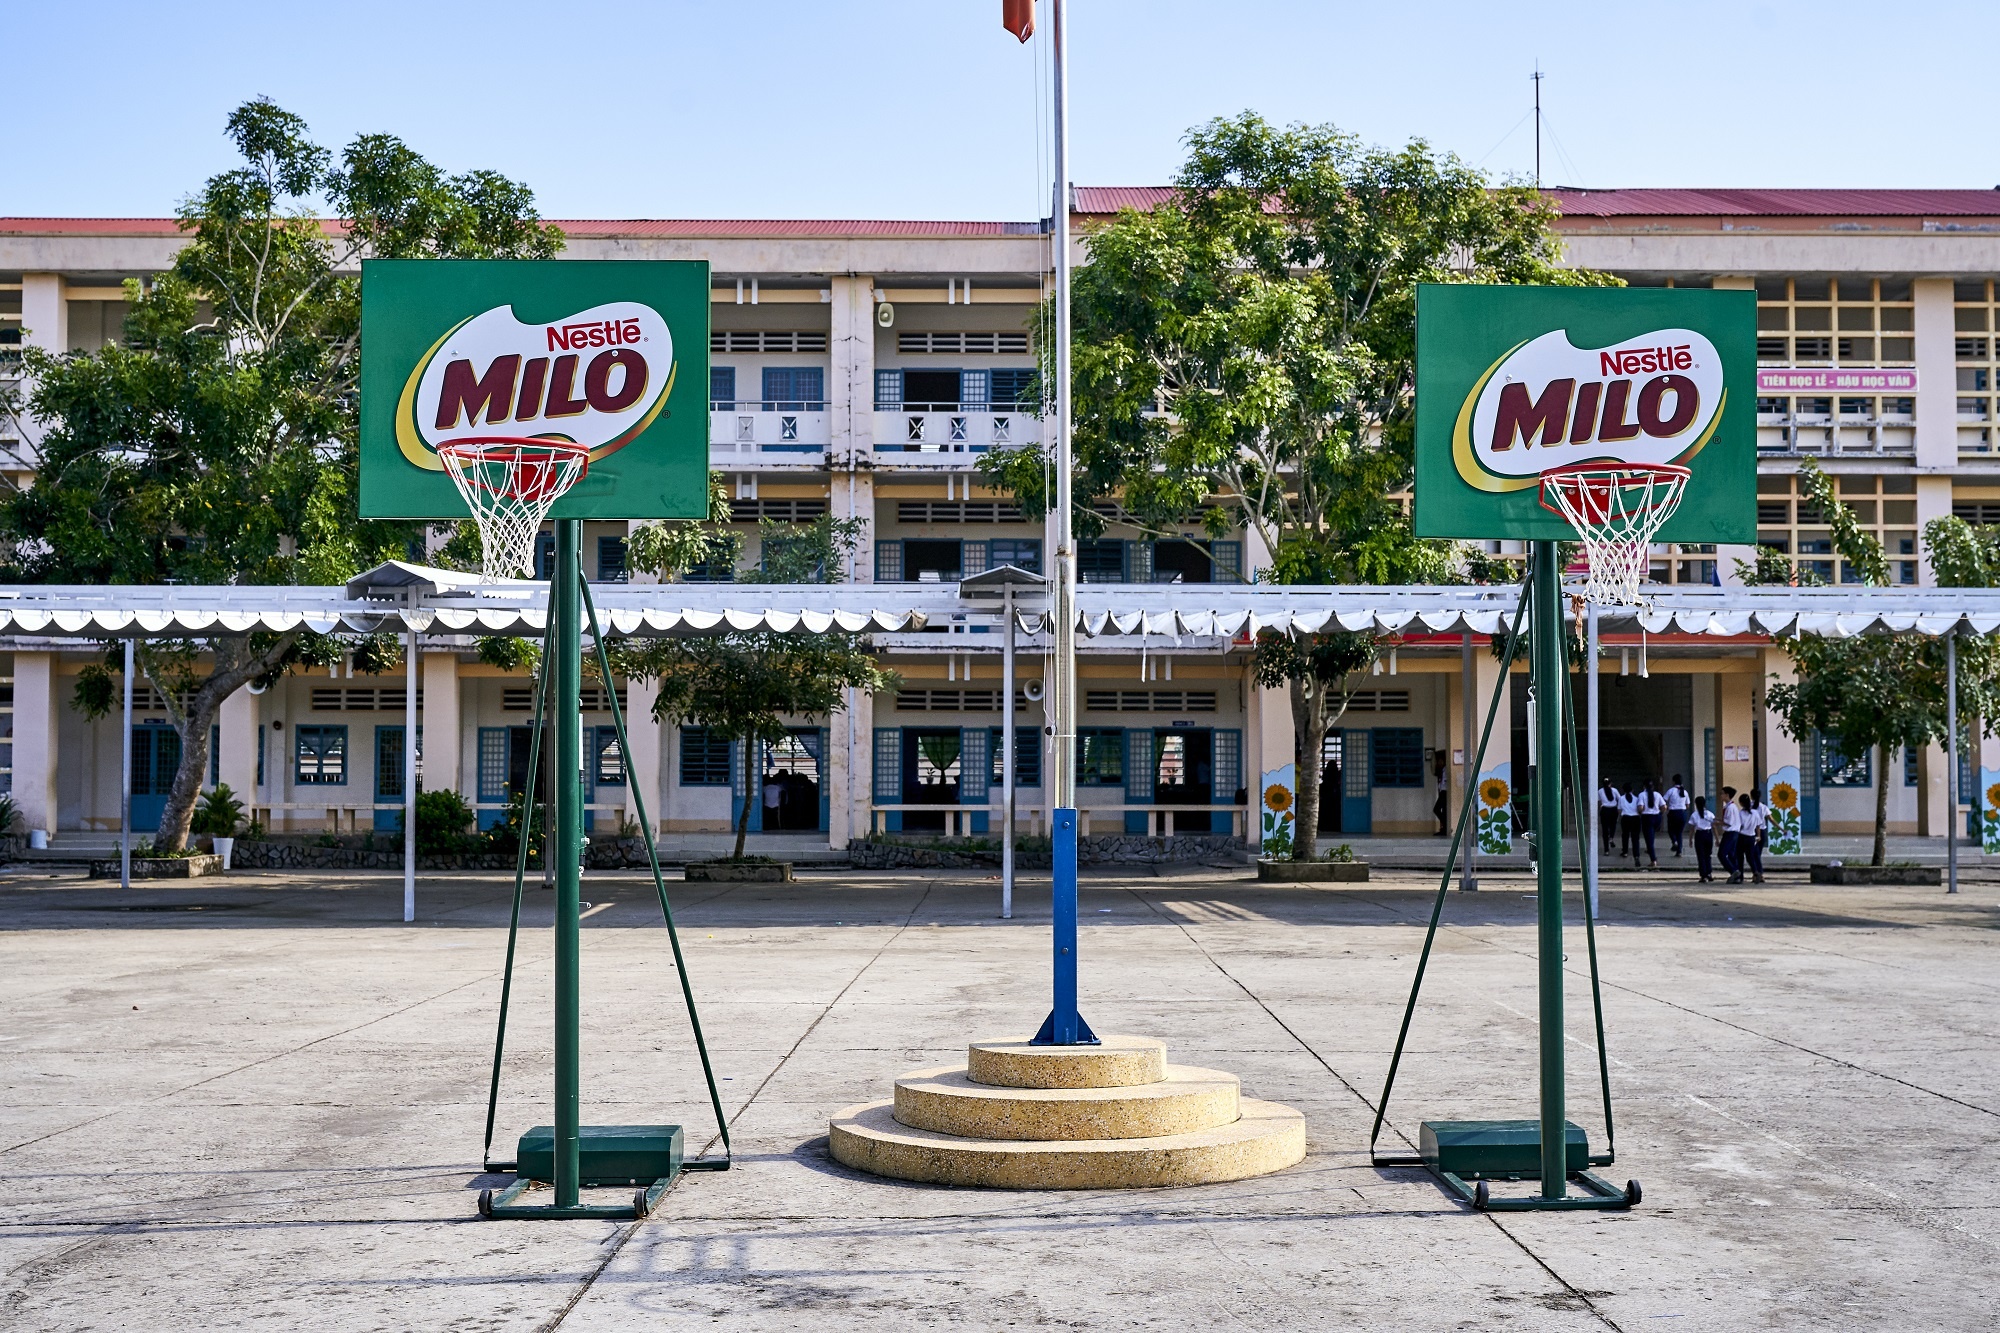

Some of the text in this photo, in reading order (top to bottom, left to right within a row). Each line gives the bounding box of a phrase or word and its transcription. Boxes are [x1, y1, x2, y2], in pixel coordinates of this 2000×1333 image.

[546, 318, 640, 351] Nestlé
[1600, 344, 1692, 376] Nestlé
[435, 348, 649, 430] MILO
[1789, 376, 1812, 388] HỌC
[1862, 376, 1885, 388] HỌC
[1491, 374, 1700, 452] MILO
